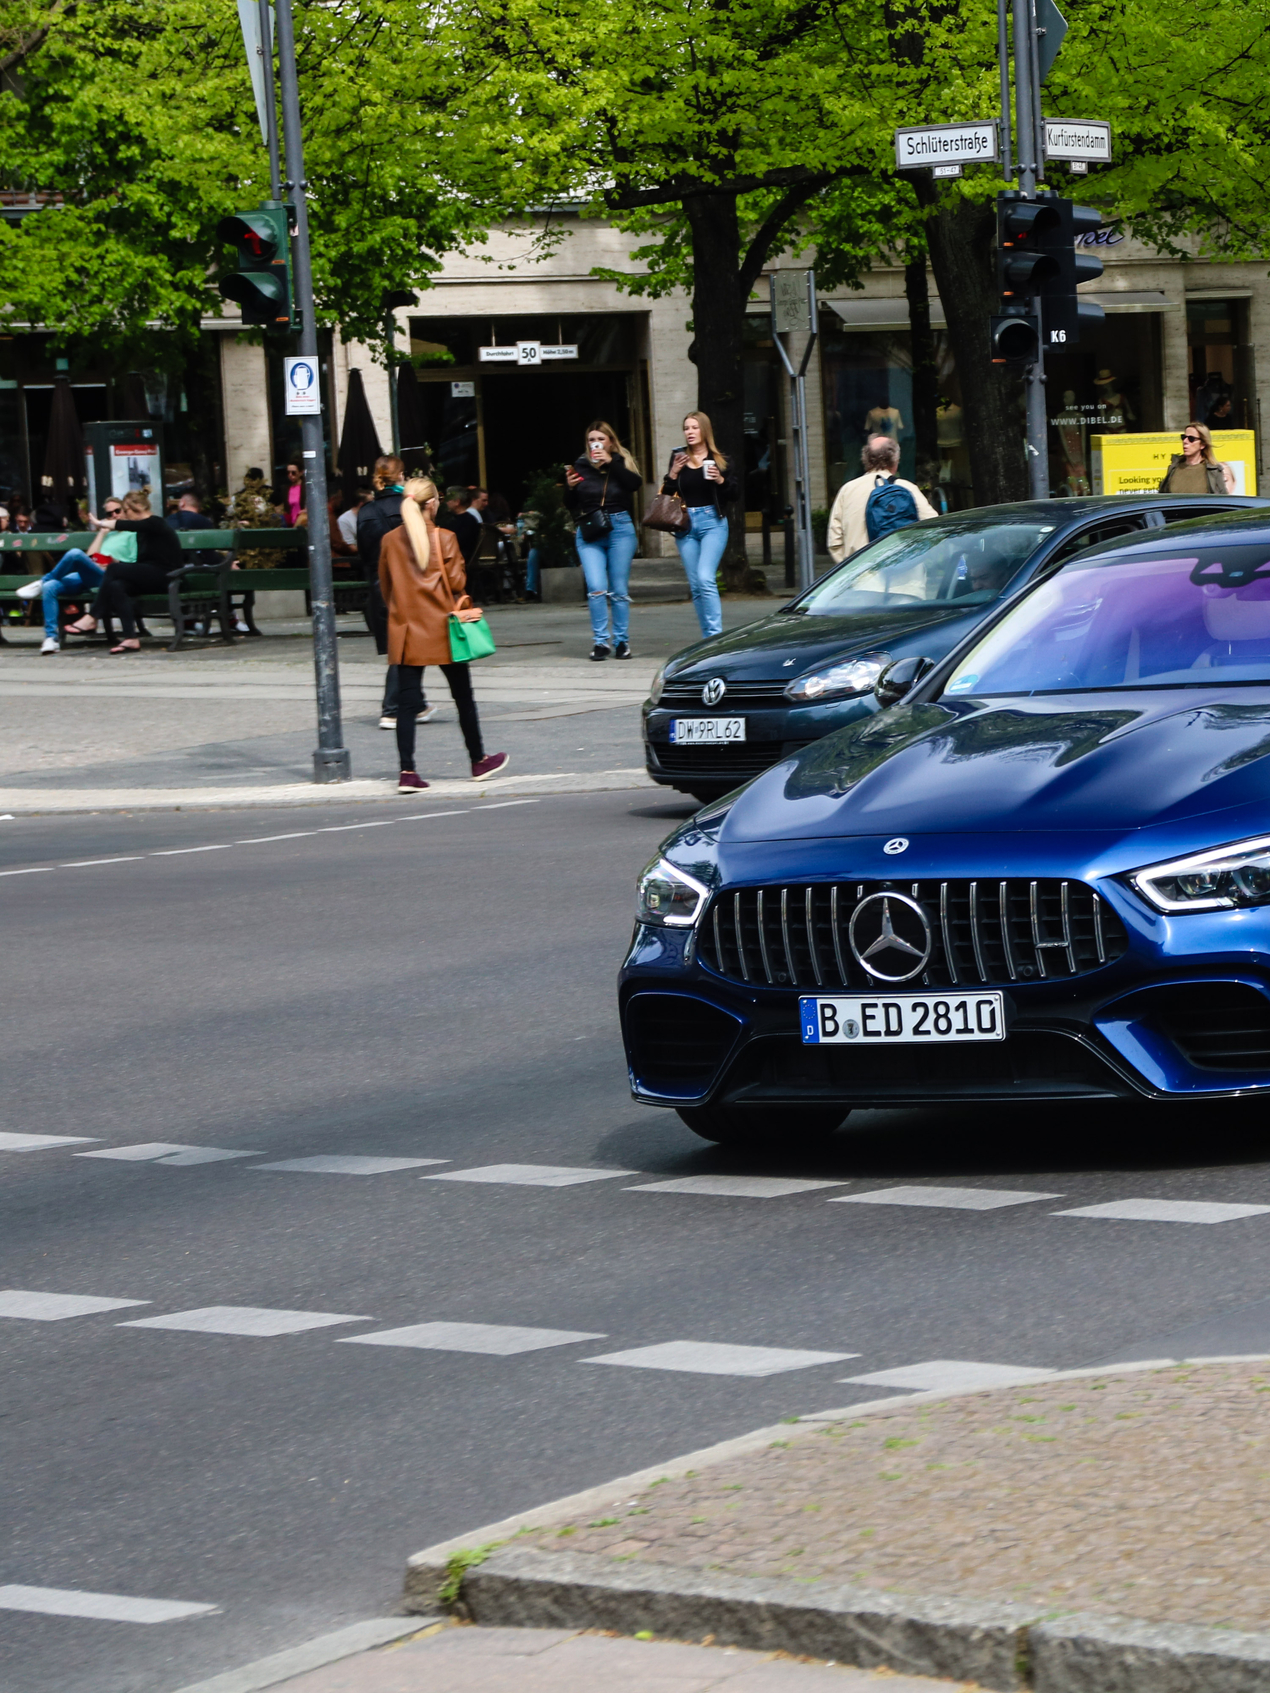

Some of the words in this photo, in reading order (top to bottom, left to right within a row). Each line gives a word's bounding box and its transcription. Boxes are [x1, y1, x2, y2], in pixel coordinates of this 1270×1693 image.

[906, 131, 988, 155] Schlüterstraße
[1047, 127, 1106, 150] Kurfürstendamm
[1050, 330, 1067, 343] K6
[522, 347, 537, 359] 50
[1051, 416, 1123, 426] WWW.DIBEL.DE
[1119, 476, 1150, 485] Looking
[678, 721, 694, 739] DW
[820, 1003, 839, 1037] B
[861, 1003, 903, 1036] ED
[911, 1000, 996, 1035] 2810
[807, 1026, 814, 1035] D
